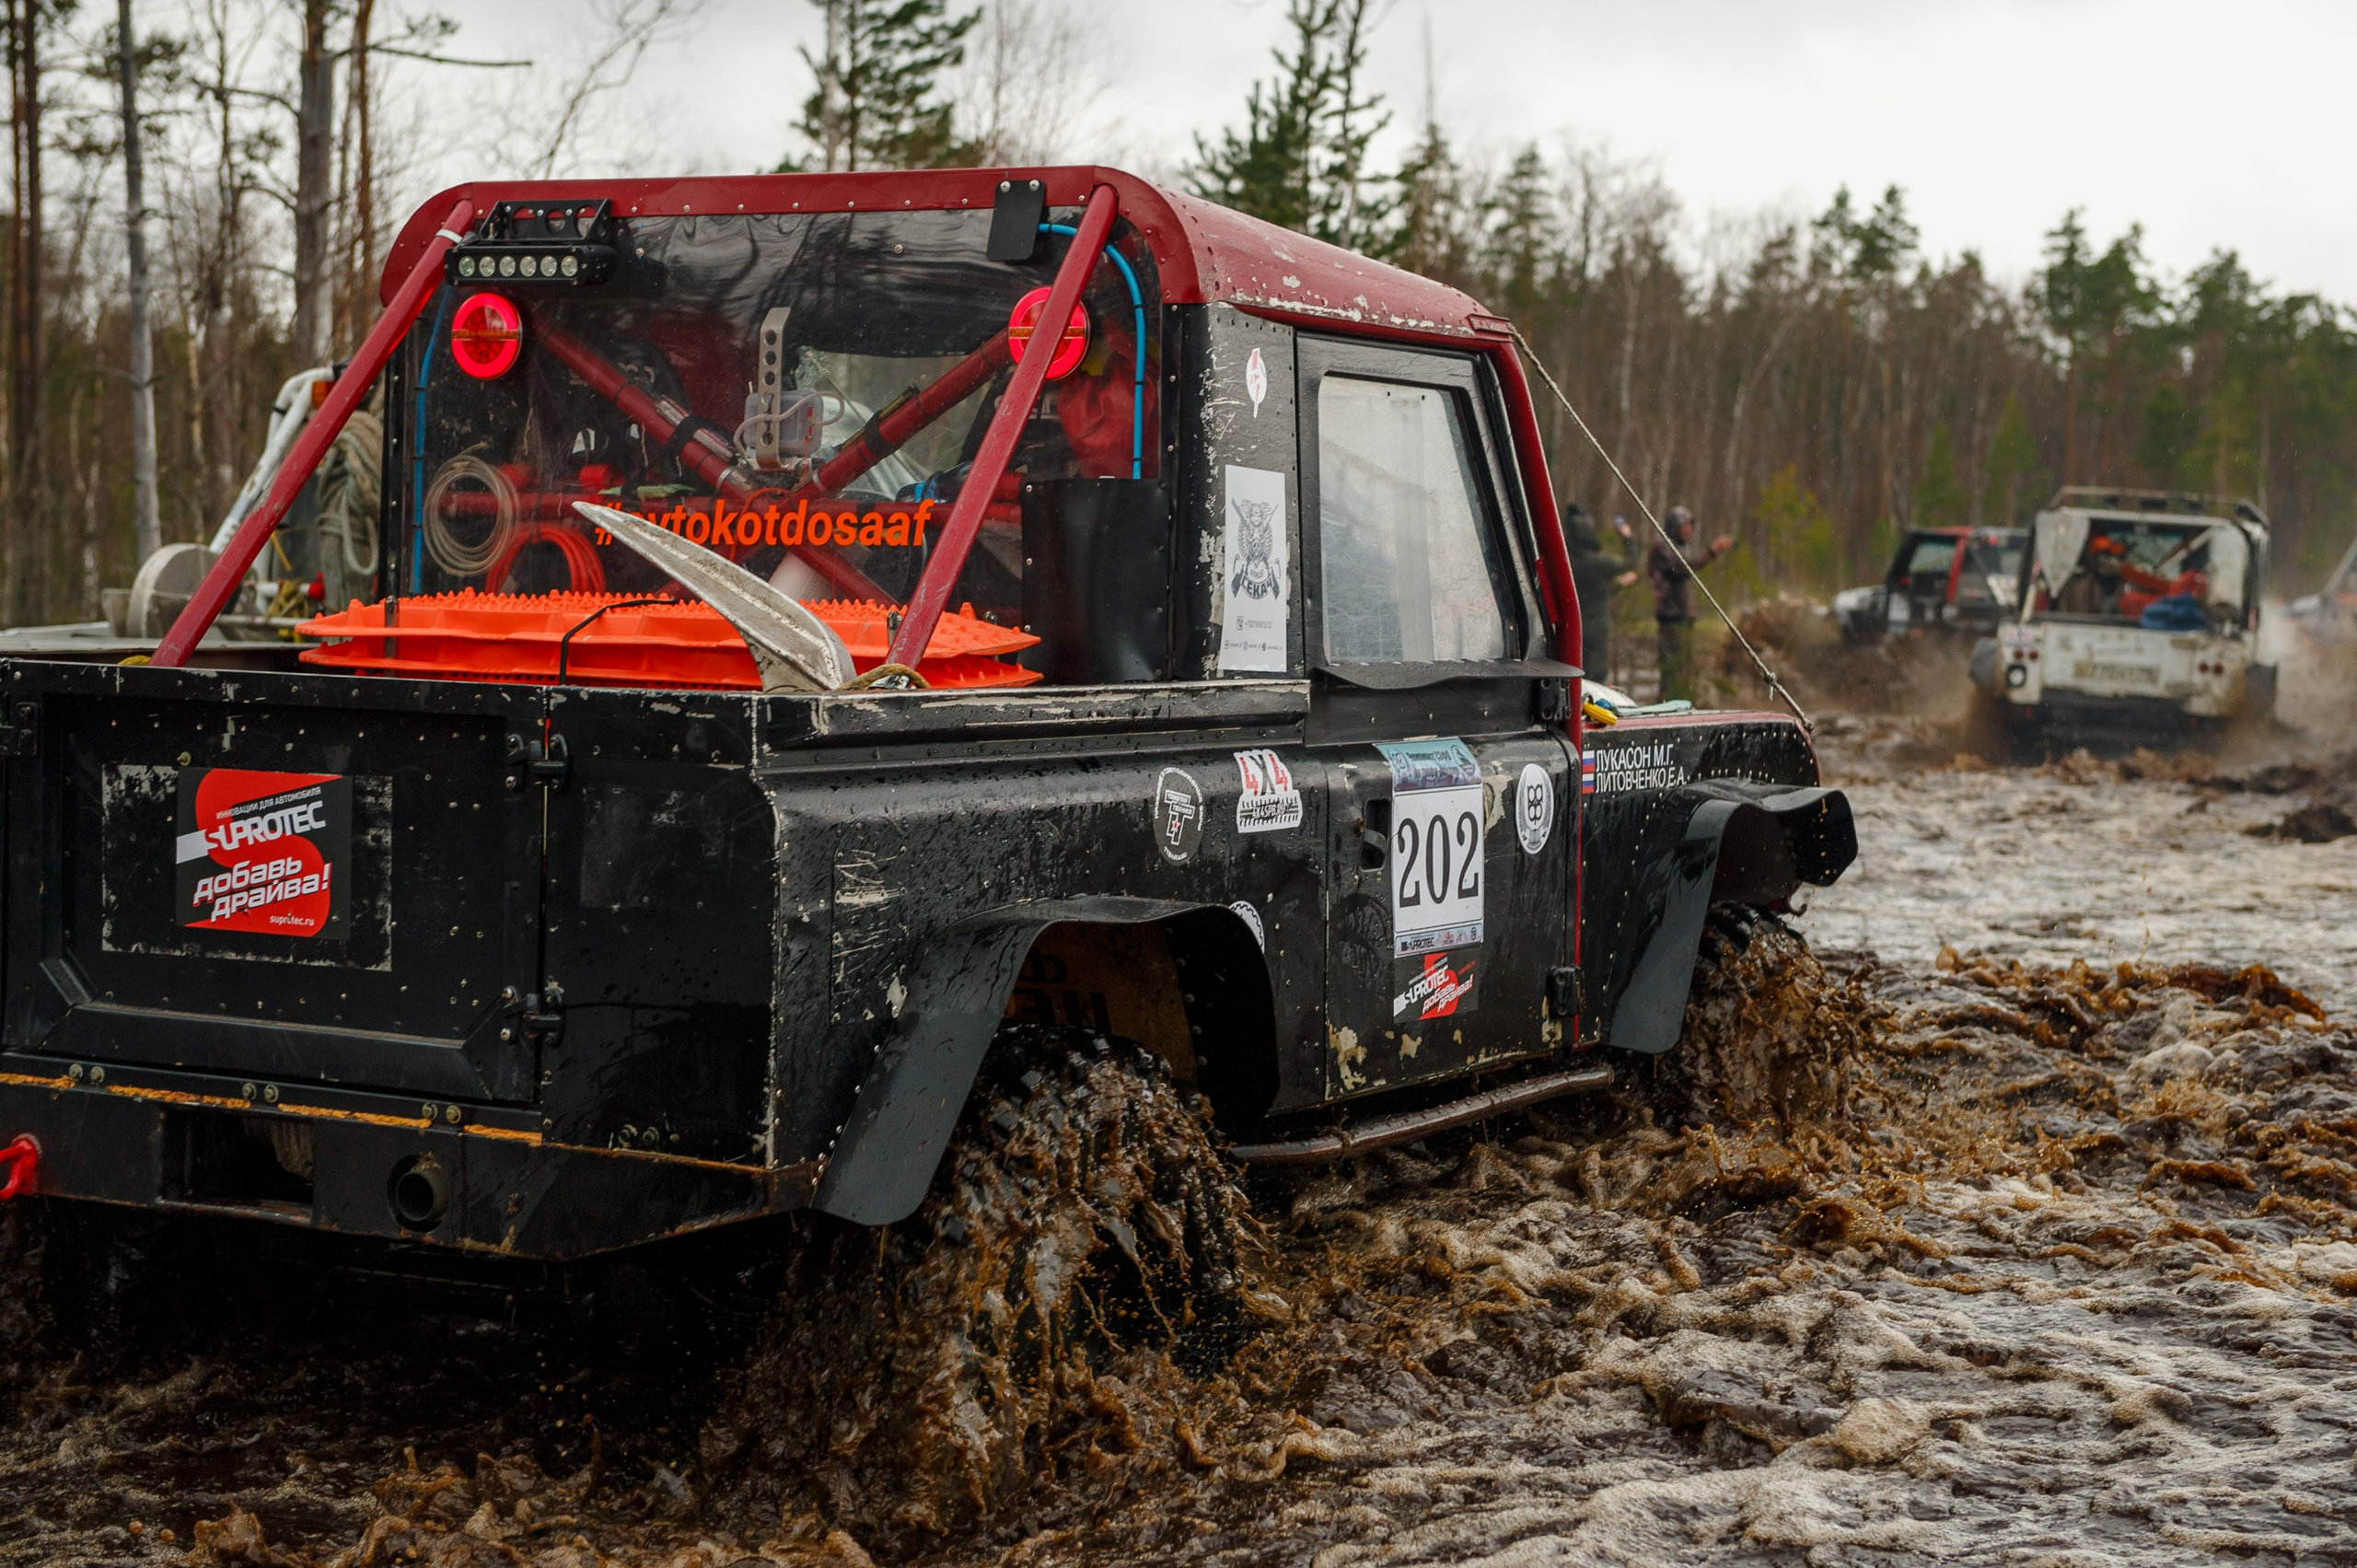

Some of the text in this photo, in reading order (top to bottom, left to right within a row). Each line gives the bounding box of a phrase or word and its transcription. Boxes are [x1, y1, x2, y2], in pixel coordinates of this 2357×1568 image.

[1241, 575, 1273, 598] СЕКАЧ
[1596, 744, 1674, 772] ЛУКАСОН М.Г.
[1596, 766, 1687, 794] ЛИТОВЧЕНКО Е.А.
[215, 786, 321, 820] ИННОВАЦИИ ДЛЯ АВТОМОБИЛЯ
[204, 800, 327, 851] SUPROTEC
[1397, 811, 1480, 909] 202
[1404, 964, 1449, 1004] SUPROTEC
